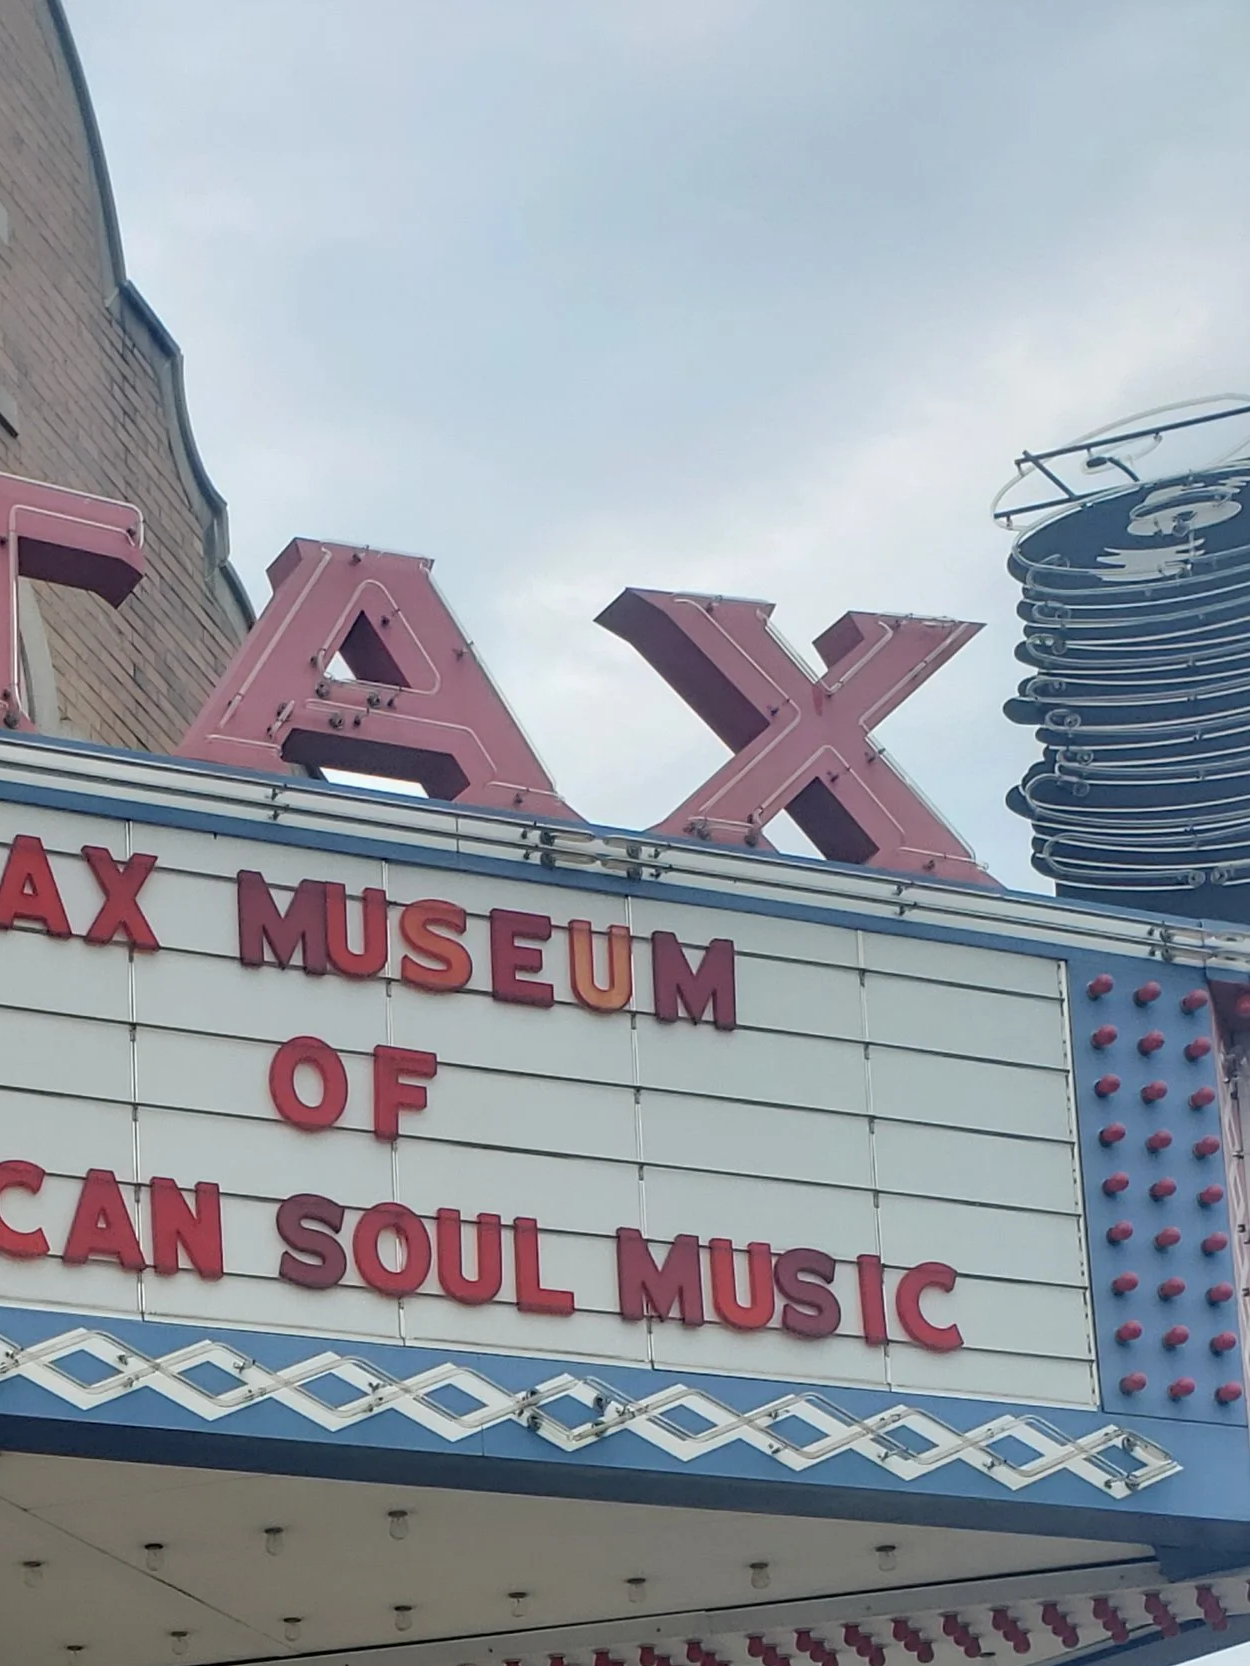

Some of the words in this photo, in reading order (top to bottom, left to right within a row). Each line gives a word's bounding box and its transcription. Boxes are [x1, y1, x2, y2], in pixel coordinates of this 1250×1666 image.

[236, 868, 738, 1032] MUSEUM
[268, 1035, 438, 1142] OF
[275, 1193, 575, 1318] SOUL
[615, 1226, 964, 1353] MUSIC
